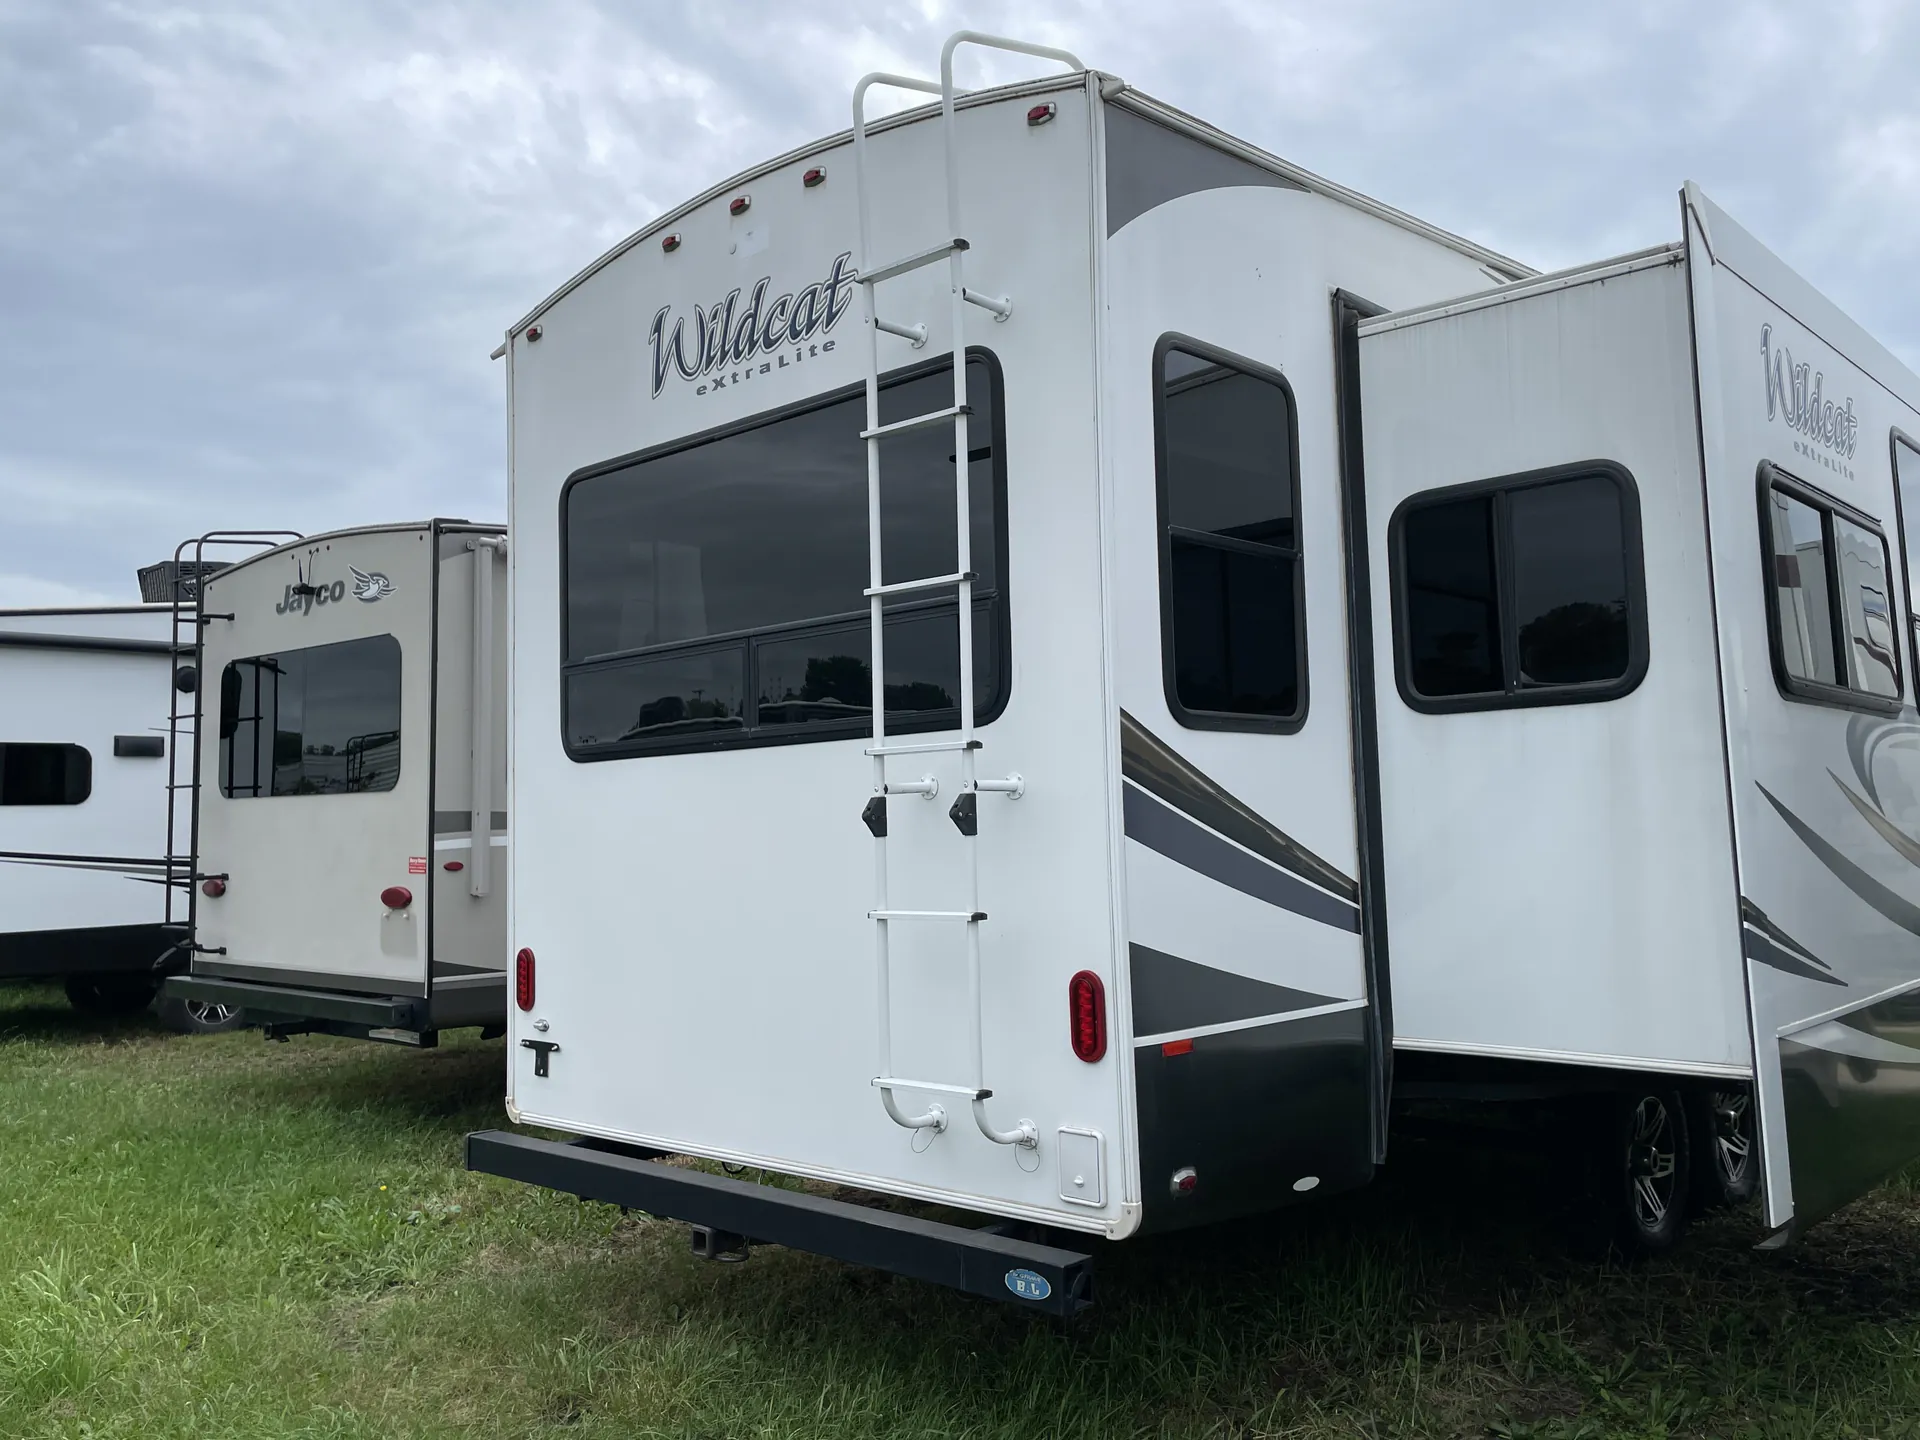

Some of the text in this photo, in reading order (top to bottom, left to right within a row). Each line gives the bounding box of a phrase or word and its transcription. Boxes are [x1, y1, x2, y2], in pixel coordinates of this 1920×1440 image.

[648, 251, 858, 400] Wildcat
[1761, 322, 1857, 460] Wildcat
[276, 580, 345, 616] Jayco
